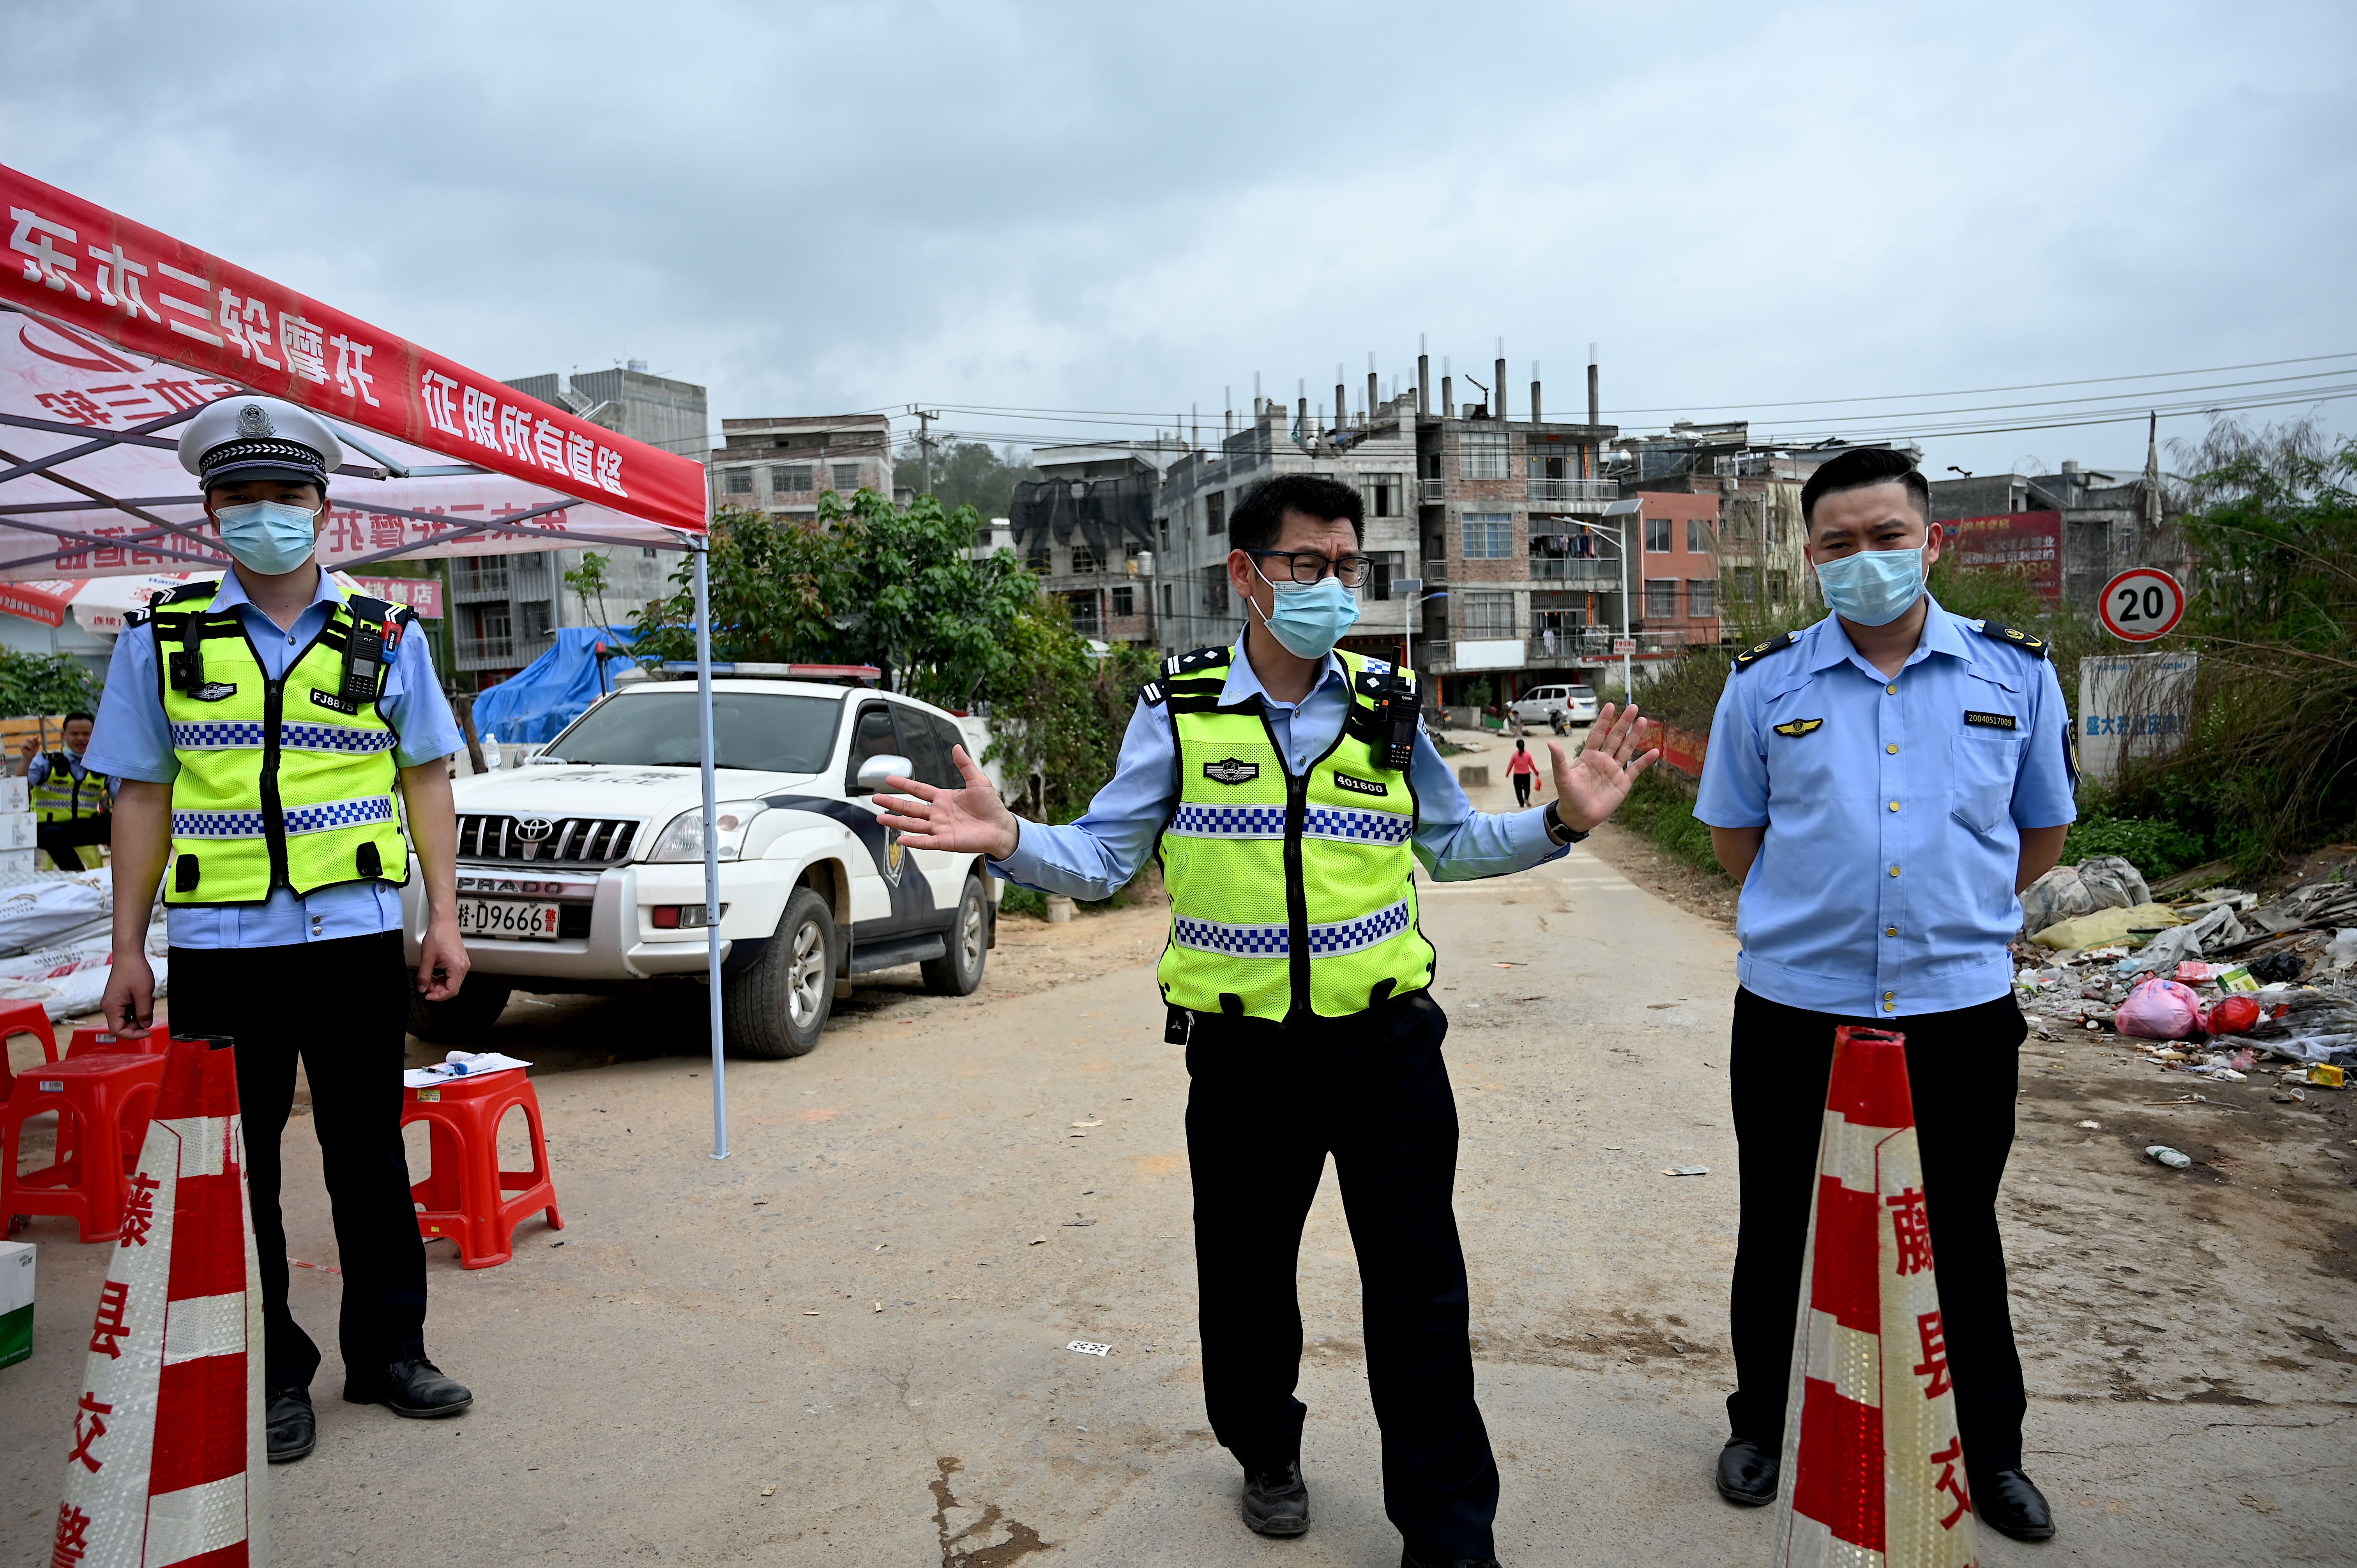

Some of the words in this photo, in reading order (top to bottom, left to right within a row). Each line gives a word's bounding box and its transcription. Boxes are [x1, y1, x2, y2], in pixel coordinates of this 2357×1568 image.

[10, 206, 380, 408] 东本三轮摩托
[421, 369, 629, 498] 征服所有道路
[364, 581, 433, 606] 销售店
[2118, 586, 2164, 622] 20
[314, 692, 354, 712] FJ8875
[1968, 714, 2012, 726] 20040517009
[530, 777, 663, 786] POLICE
[1338, 776, 1383, 793] 401600
[457, 877, 564, 894] PRADO
[1886, 1185, 1979, 1568] 藤县交
